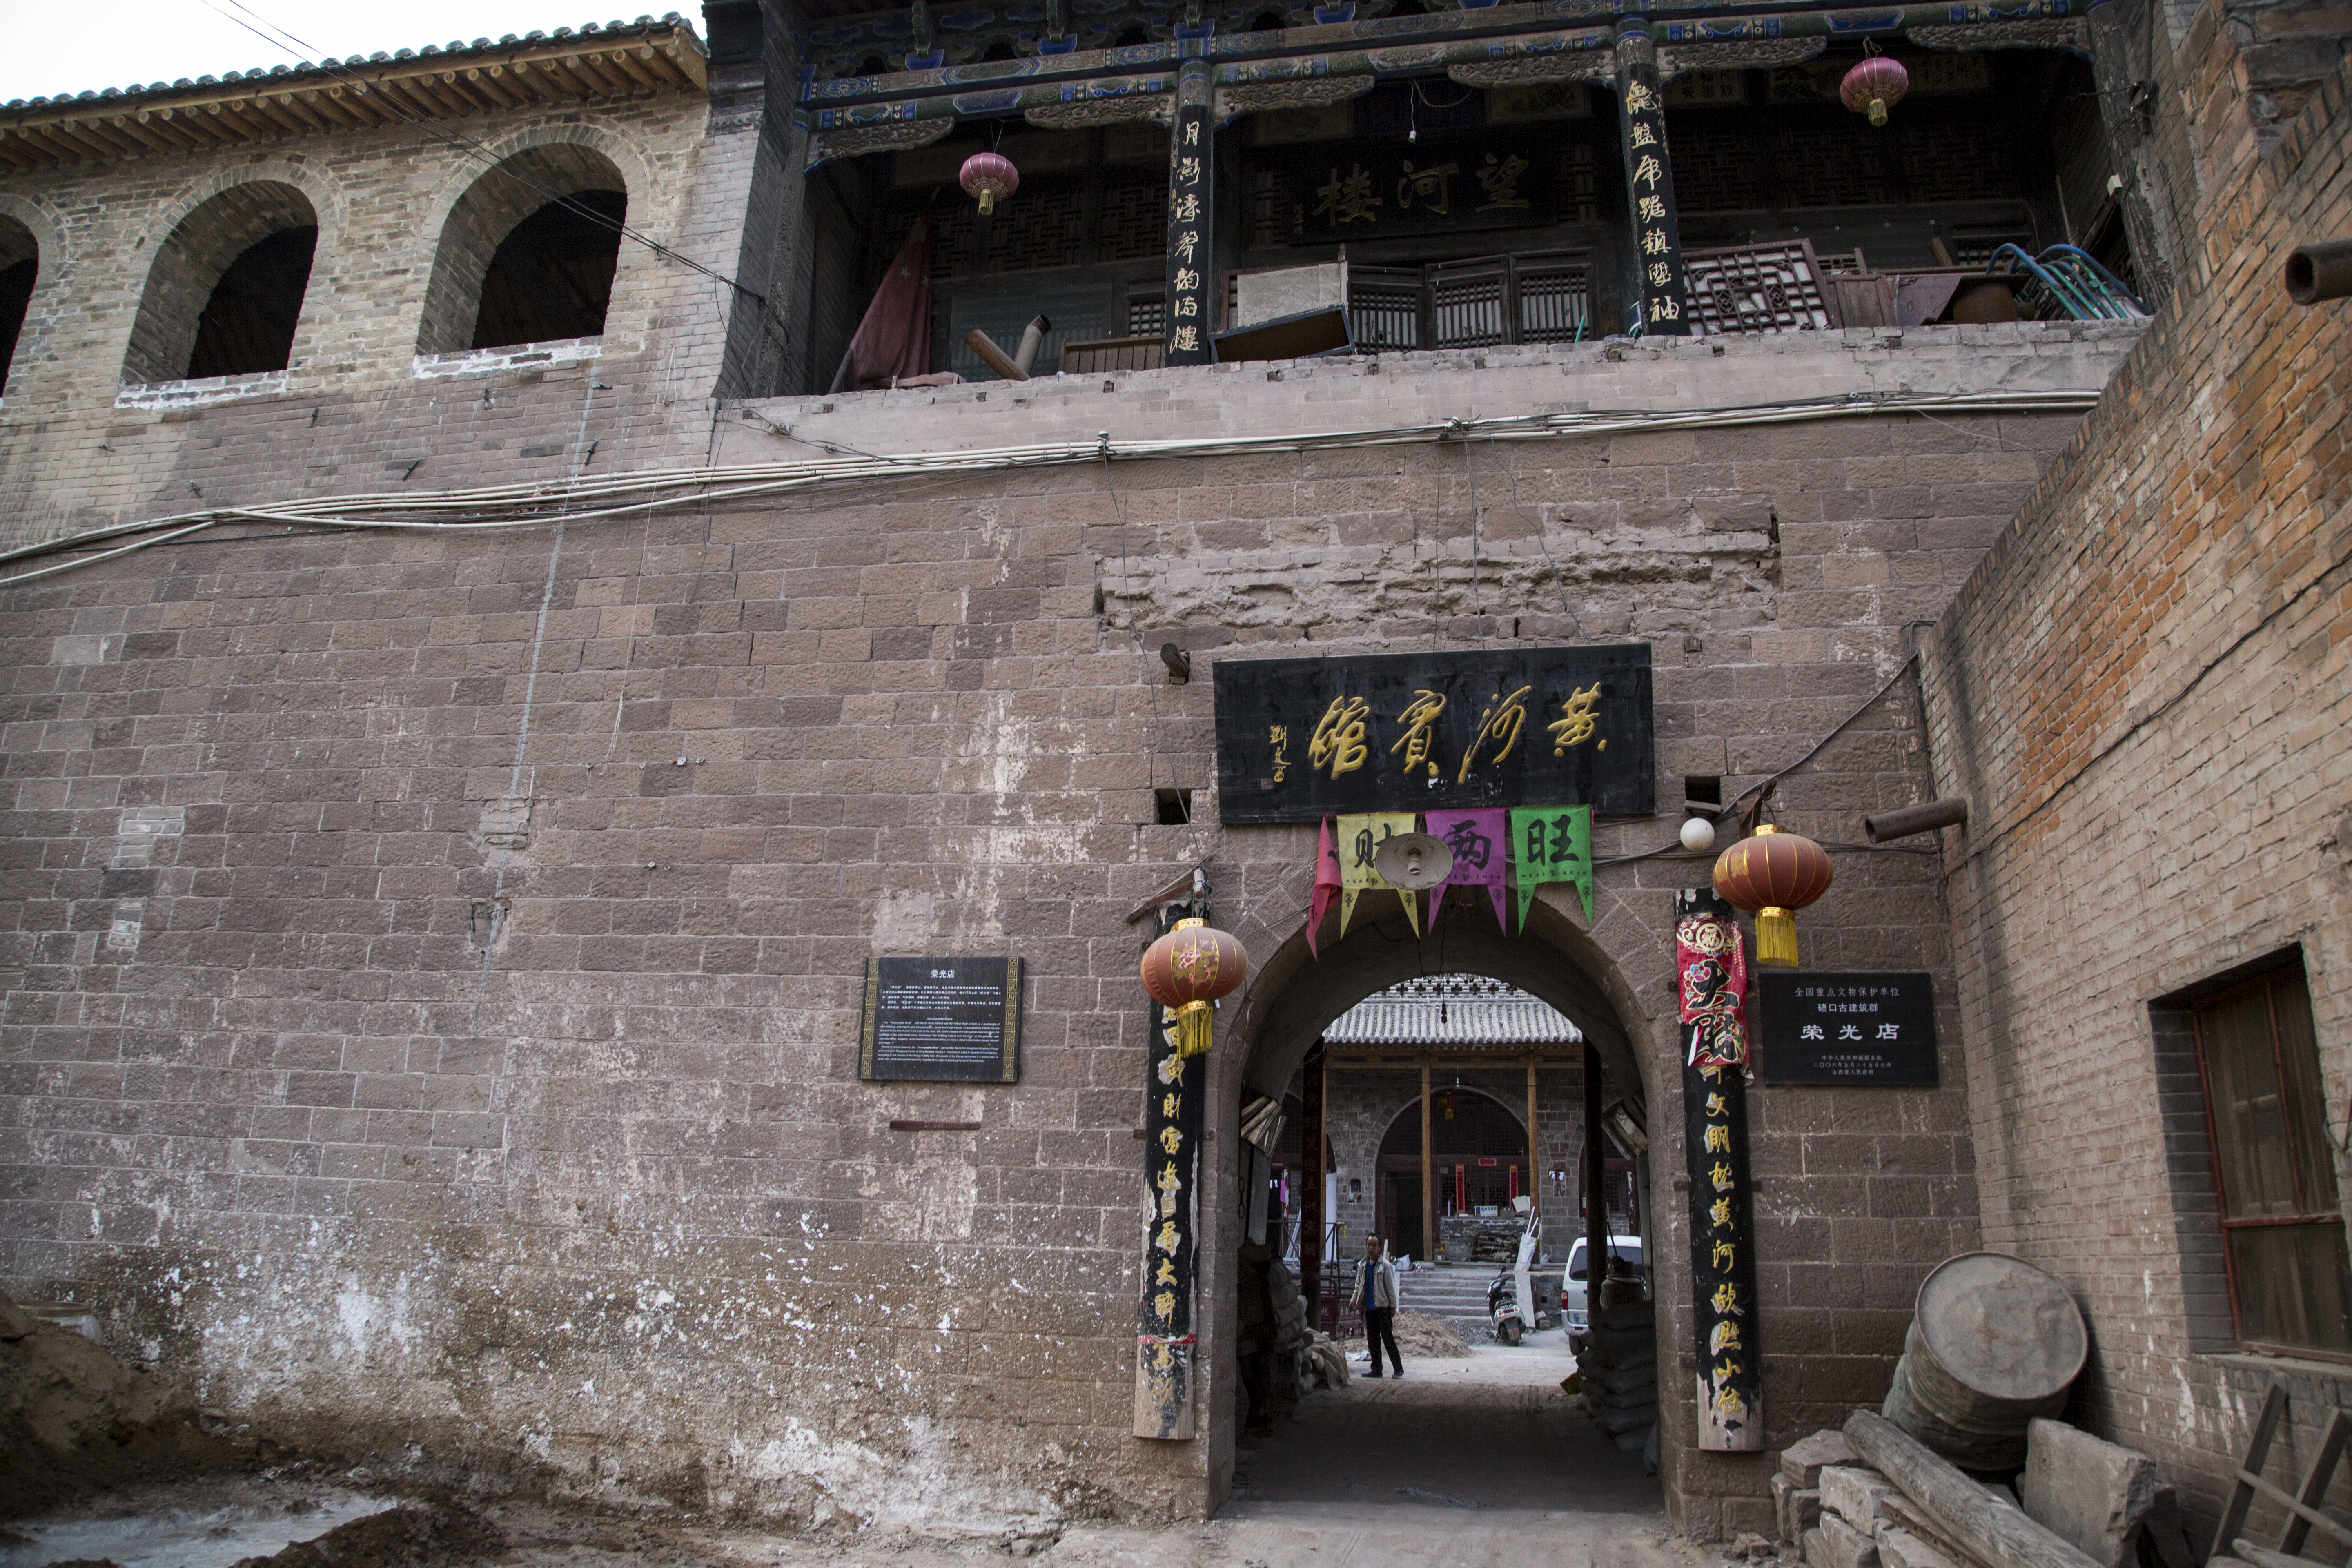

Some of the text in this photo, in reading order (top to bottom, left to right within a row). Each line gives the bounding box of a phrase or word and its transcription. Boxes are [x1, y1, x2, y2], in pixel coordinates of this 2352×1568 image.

[1527, 814, 1580, 866] 旺
[931, 969, 956, 979] 荣光店
[1795, 987, 1900, 997] 全国重点文物保护单位
[1817, 1003, 1879, 1013] 碛口古建筑群
[1800, 1023, 1900, 1041] 荣光店
